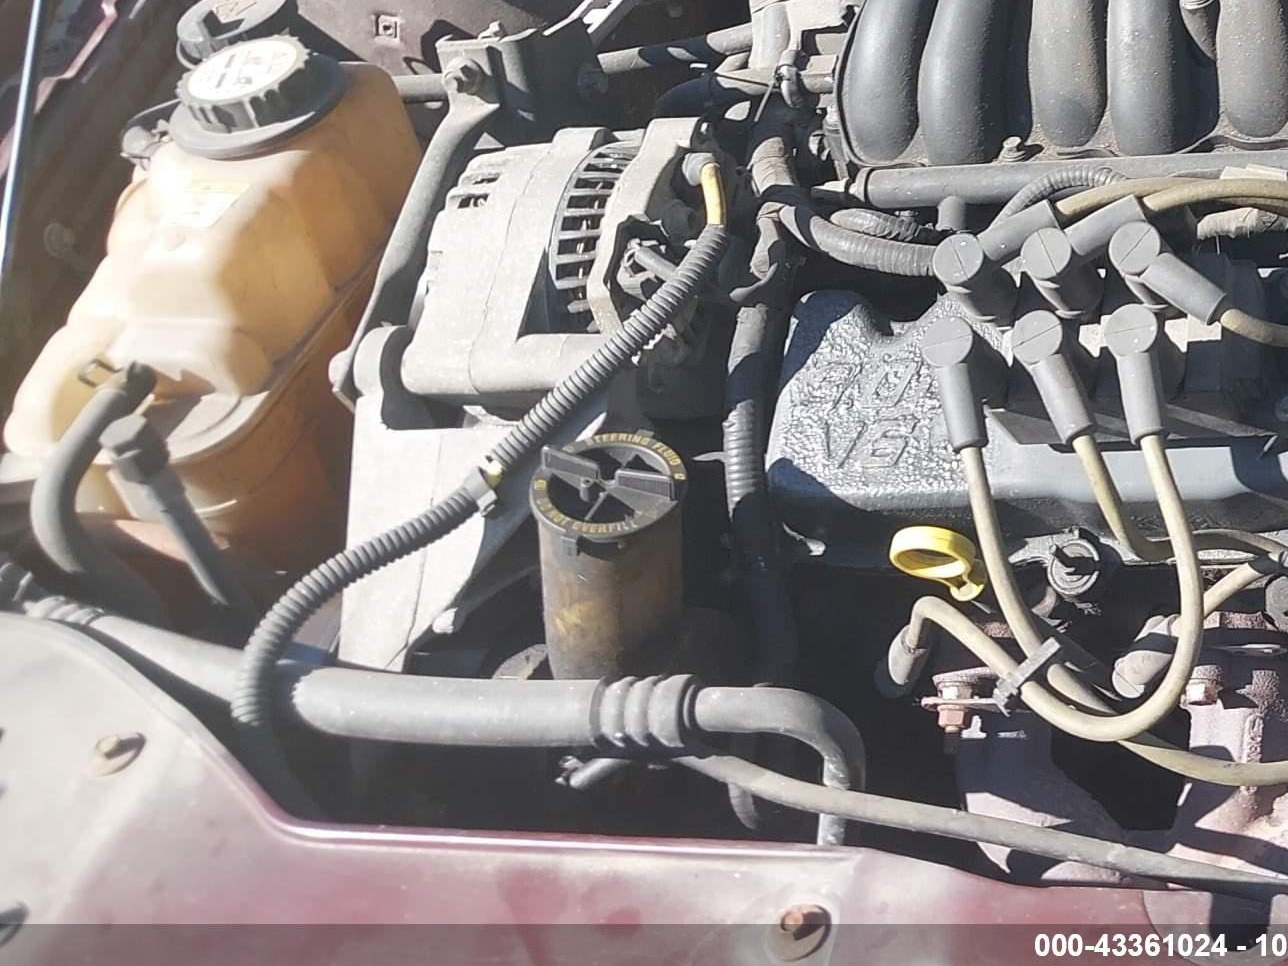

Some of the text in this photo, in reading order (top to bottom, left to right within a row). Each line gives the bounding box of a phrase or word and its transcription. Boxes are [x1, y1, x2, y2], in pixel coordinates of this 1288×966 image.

[584, 433, 681, 466] STEERING FLUID
[571, 518, 639, 533] OVERFILL
